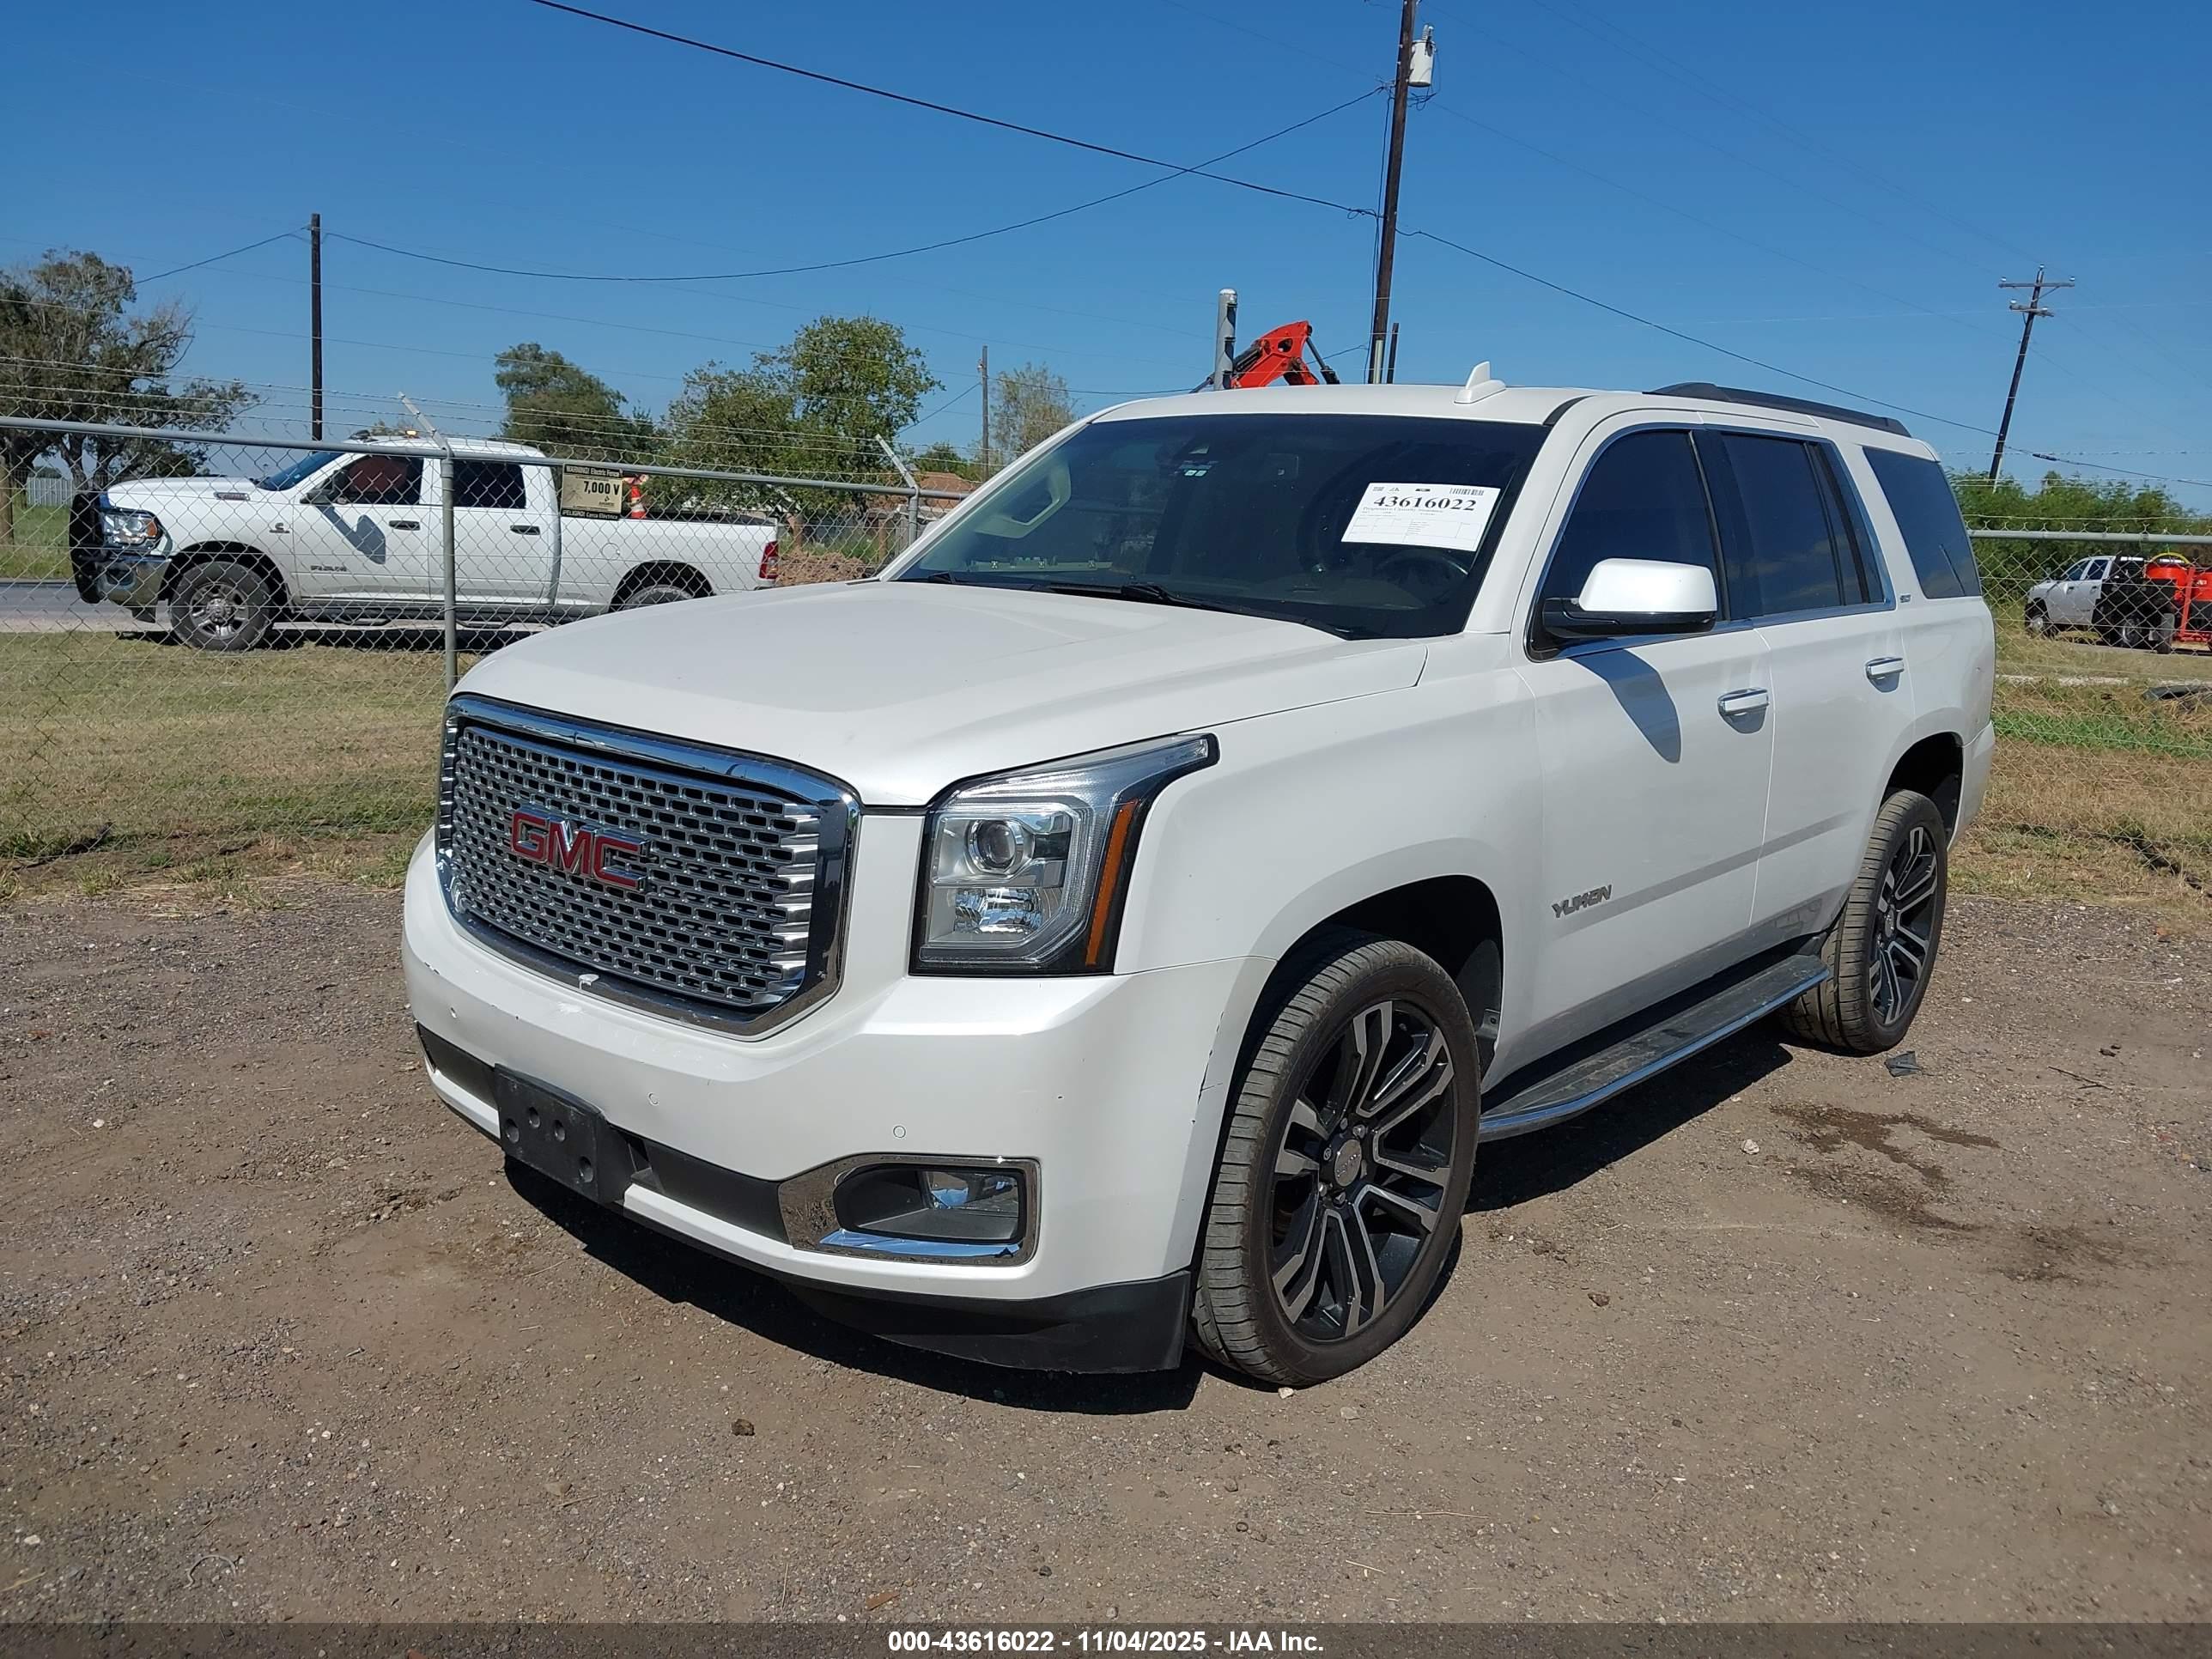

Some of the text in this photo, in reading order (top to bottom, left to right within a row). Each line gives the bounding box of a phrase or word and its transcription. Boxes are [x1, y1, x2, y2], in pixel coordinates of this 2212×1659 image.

[584, 481, 620, 495] 7,000 V
[1374, 495, 1477, 511] 43616022
[510, 804, 648, 893] GMC
[1551, 884, 1613, 919] YUKON
